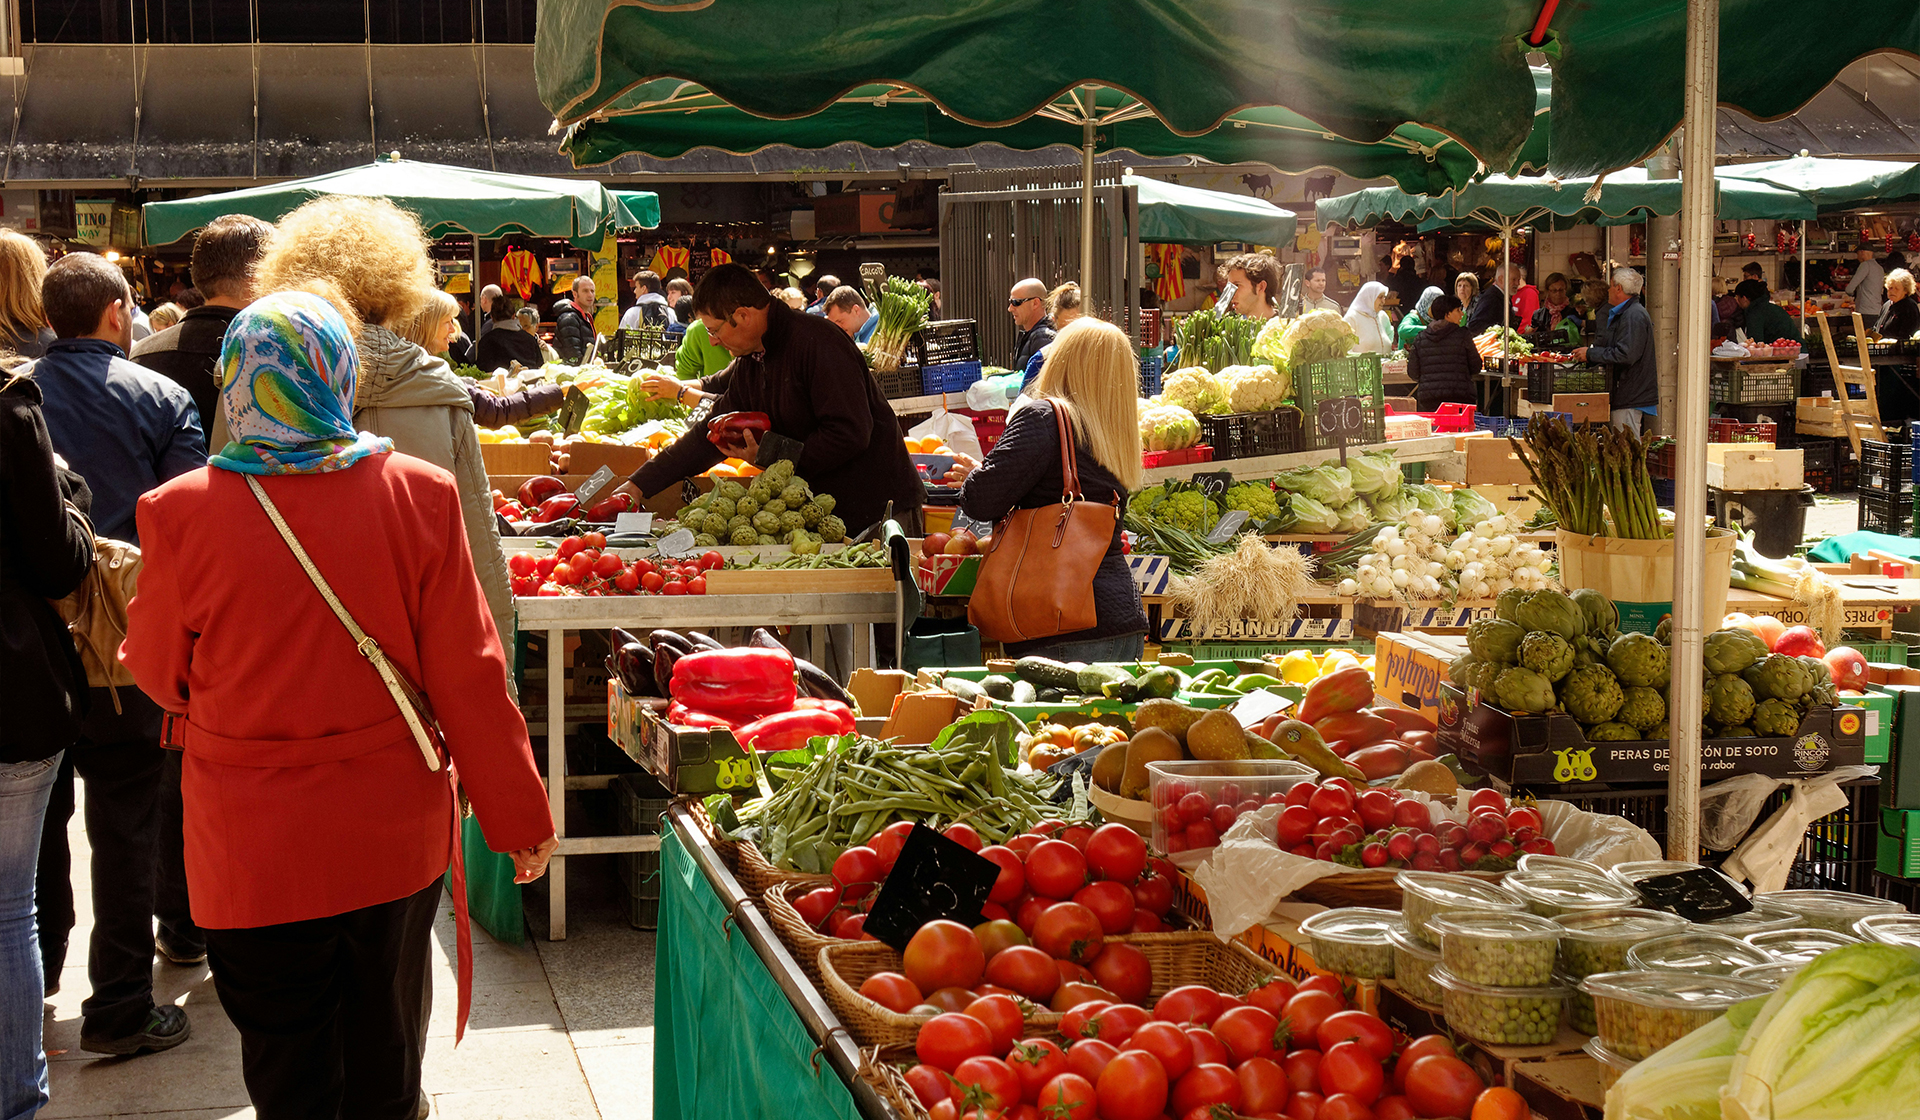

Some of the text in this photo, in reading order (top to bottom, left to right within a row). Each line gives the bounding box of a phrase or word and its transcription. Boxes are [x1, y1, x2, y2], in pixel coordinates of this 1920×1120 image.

[78, 229, 100, 237] WAY
[1610, 750, 1650, 760] PERAS
[1654, 749, 1670, 759] DE
[1726, 747, 1741, 757] DE
[1745, 746, 1778, 756] SOTO
[1709, 760, 1736, 770] sabor
